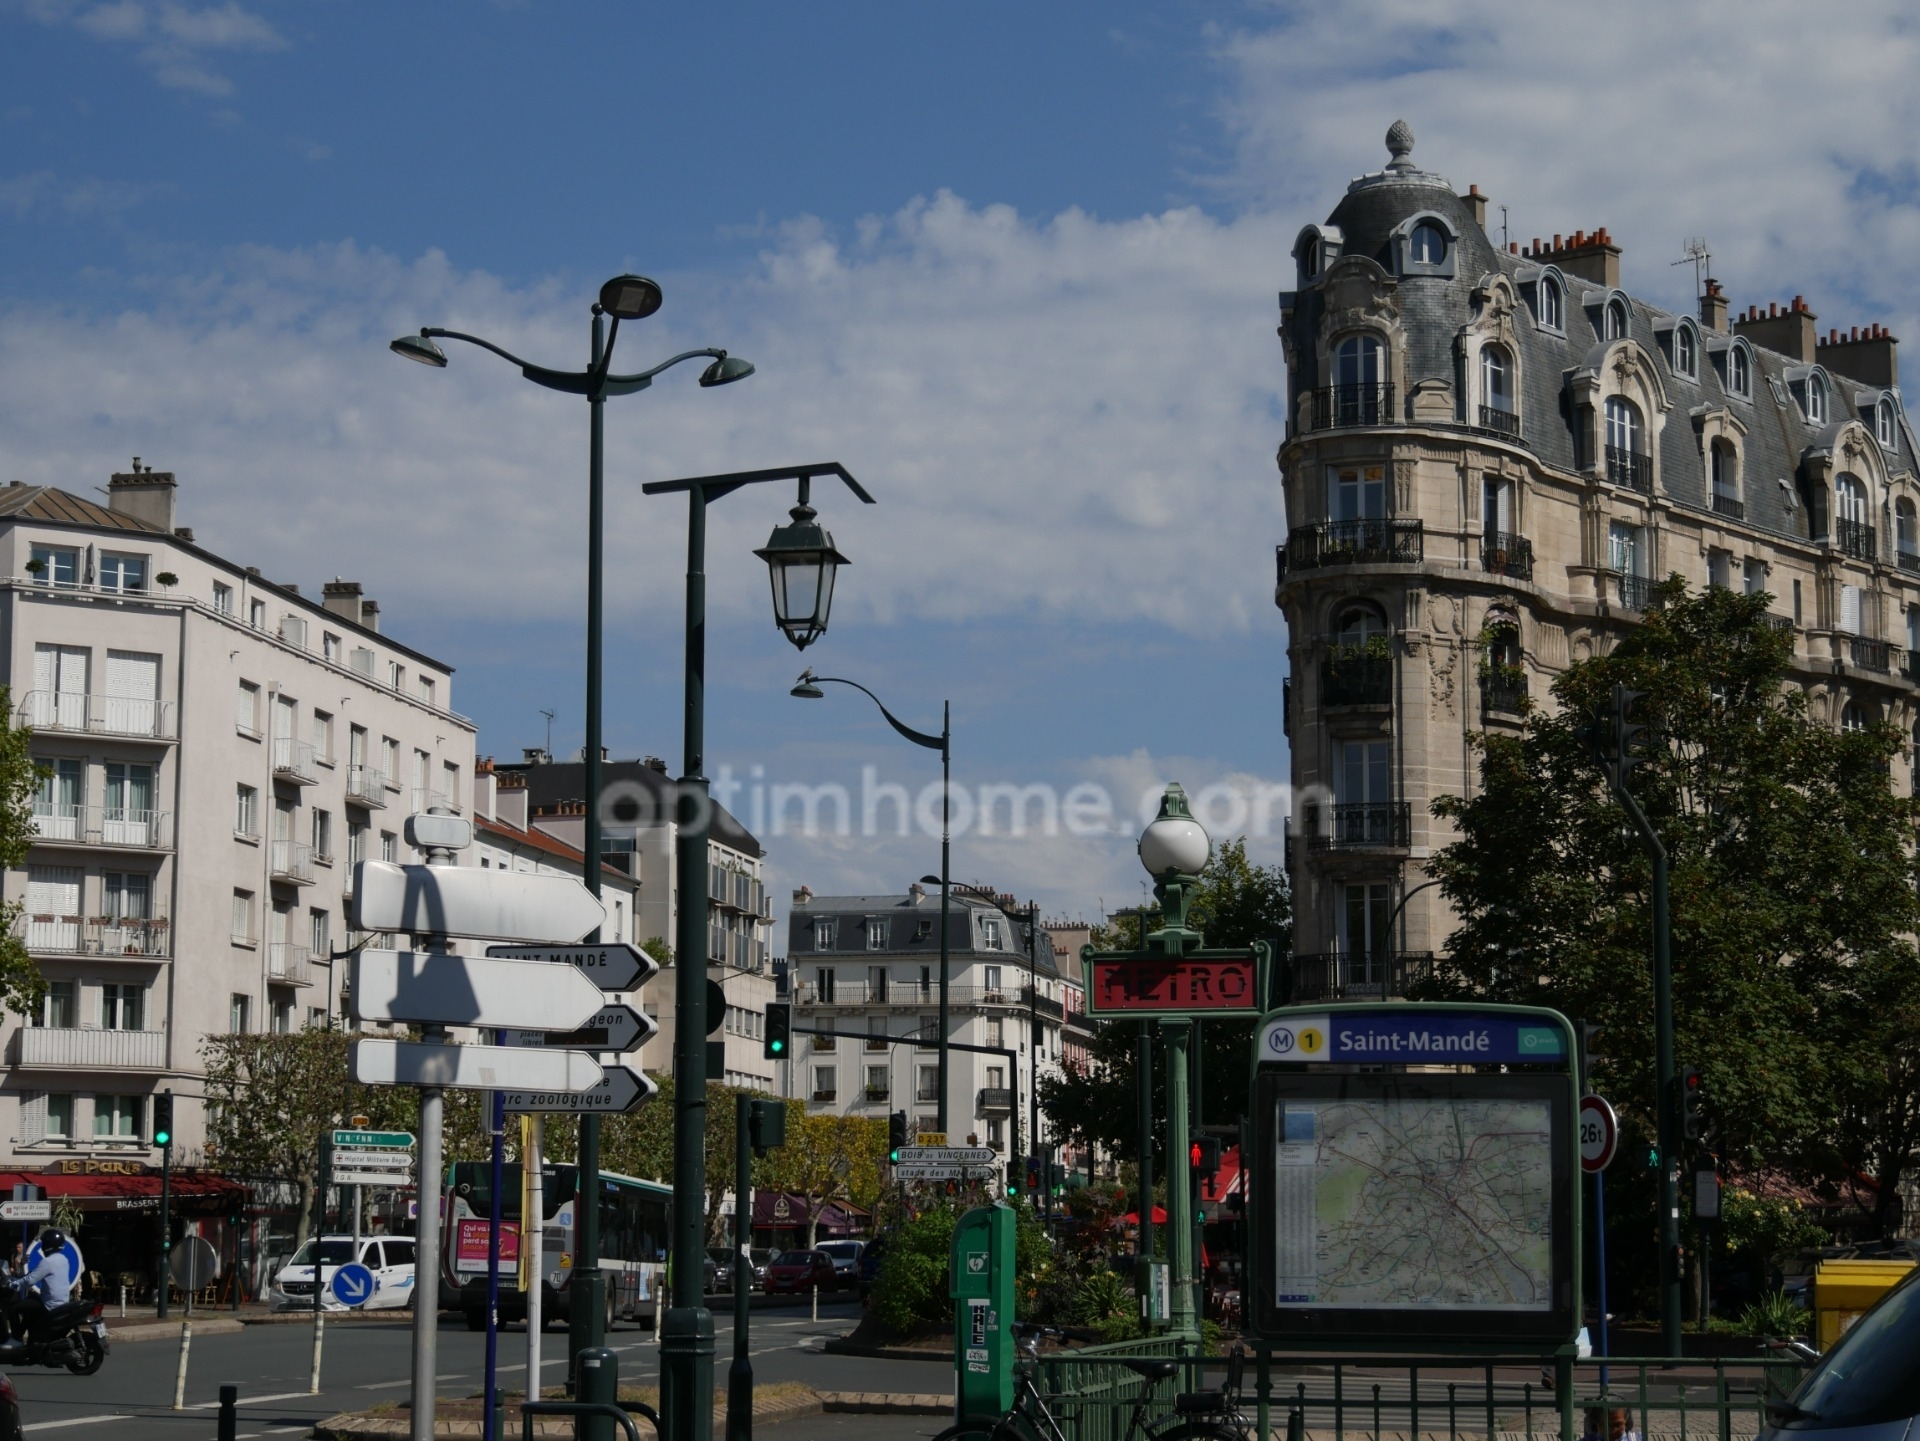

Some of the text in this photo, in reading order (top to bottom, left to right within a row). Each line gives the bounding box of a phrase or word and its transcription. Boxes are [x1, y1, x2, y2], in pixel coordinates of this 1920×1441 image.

[549, 951, 607, 967] MANDÉ
[584, 1013, 623, 1028] geon
[1304, 1032, 1314, 1048] 1
[1339, 1030, 1490, 1051] Saint-Mandé
[530, 1094, 612, 1108] zoologique
[918, 1135, 945, 1143] D 237
[937, 1151, 987, 1160] VINCENNES
[929, 1168, 945, 1176] des
[116, 1199, 160, 1208] BRASSERIE
[552, 1272, 561, 1282] 70
